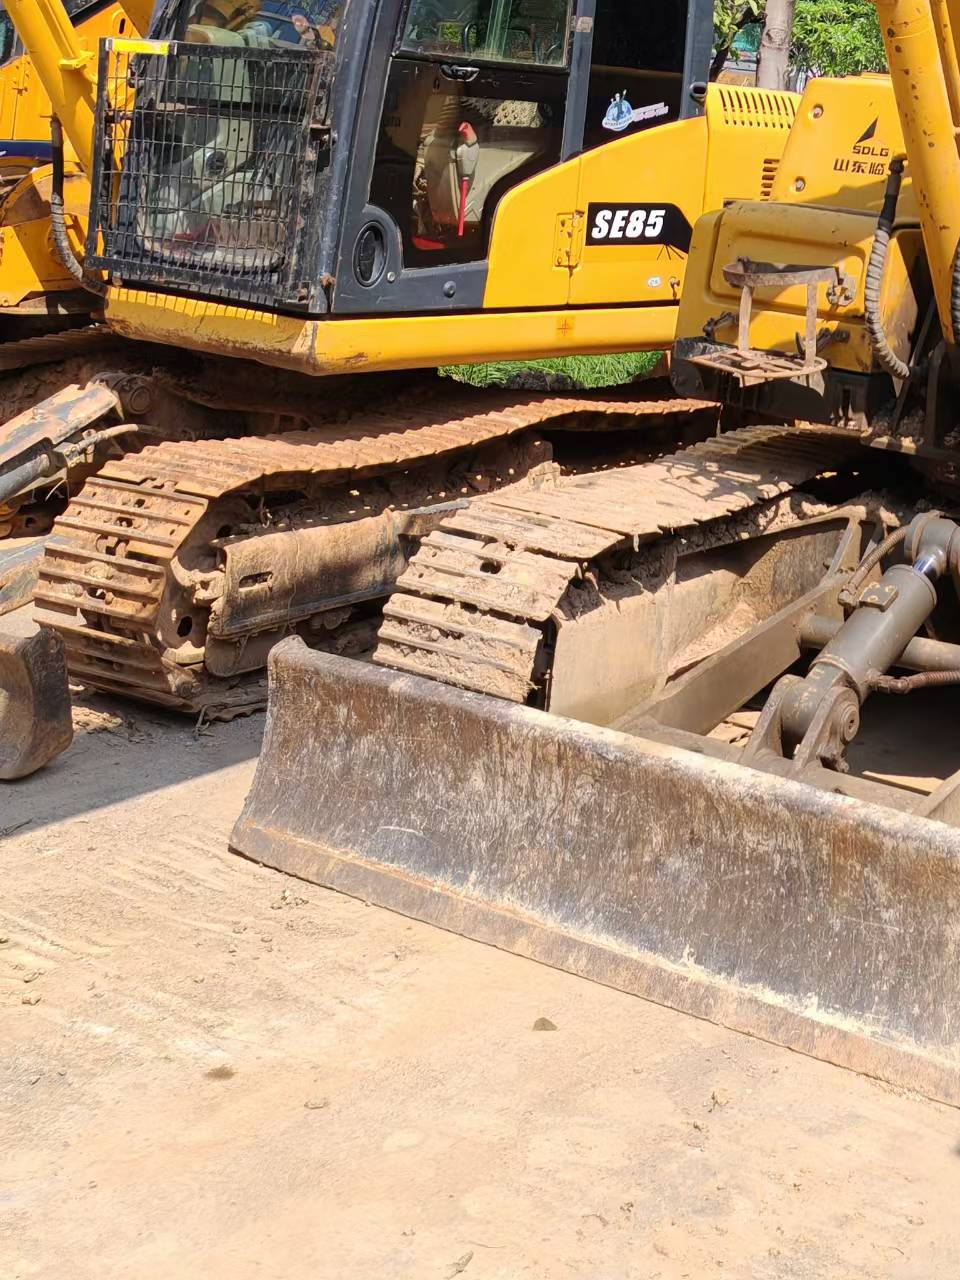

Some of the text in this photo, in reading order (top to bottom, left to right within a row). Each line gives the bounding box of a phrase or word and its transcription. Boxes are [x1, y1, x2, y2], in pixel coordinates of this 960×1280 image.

[852, 145, 889, 157] SDLG
[833, 158, 891, 176] 山东临
[591, 209, 666, 239] SE85
